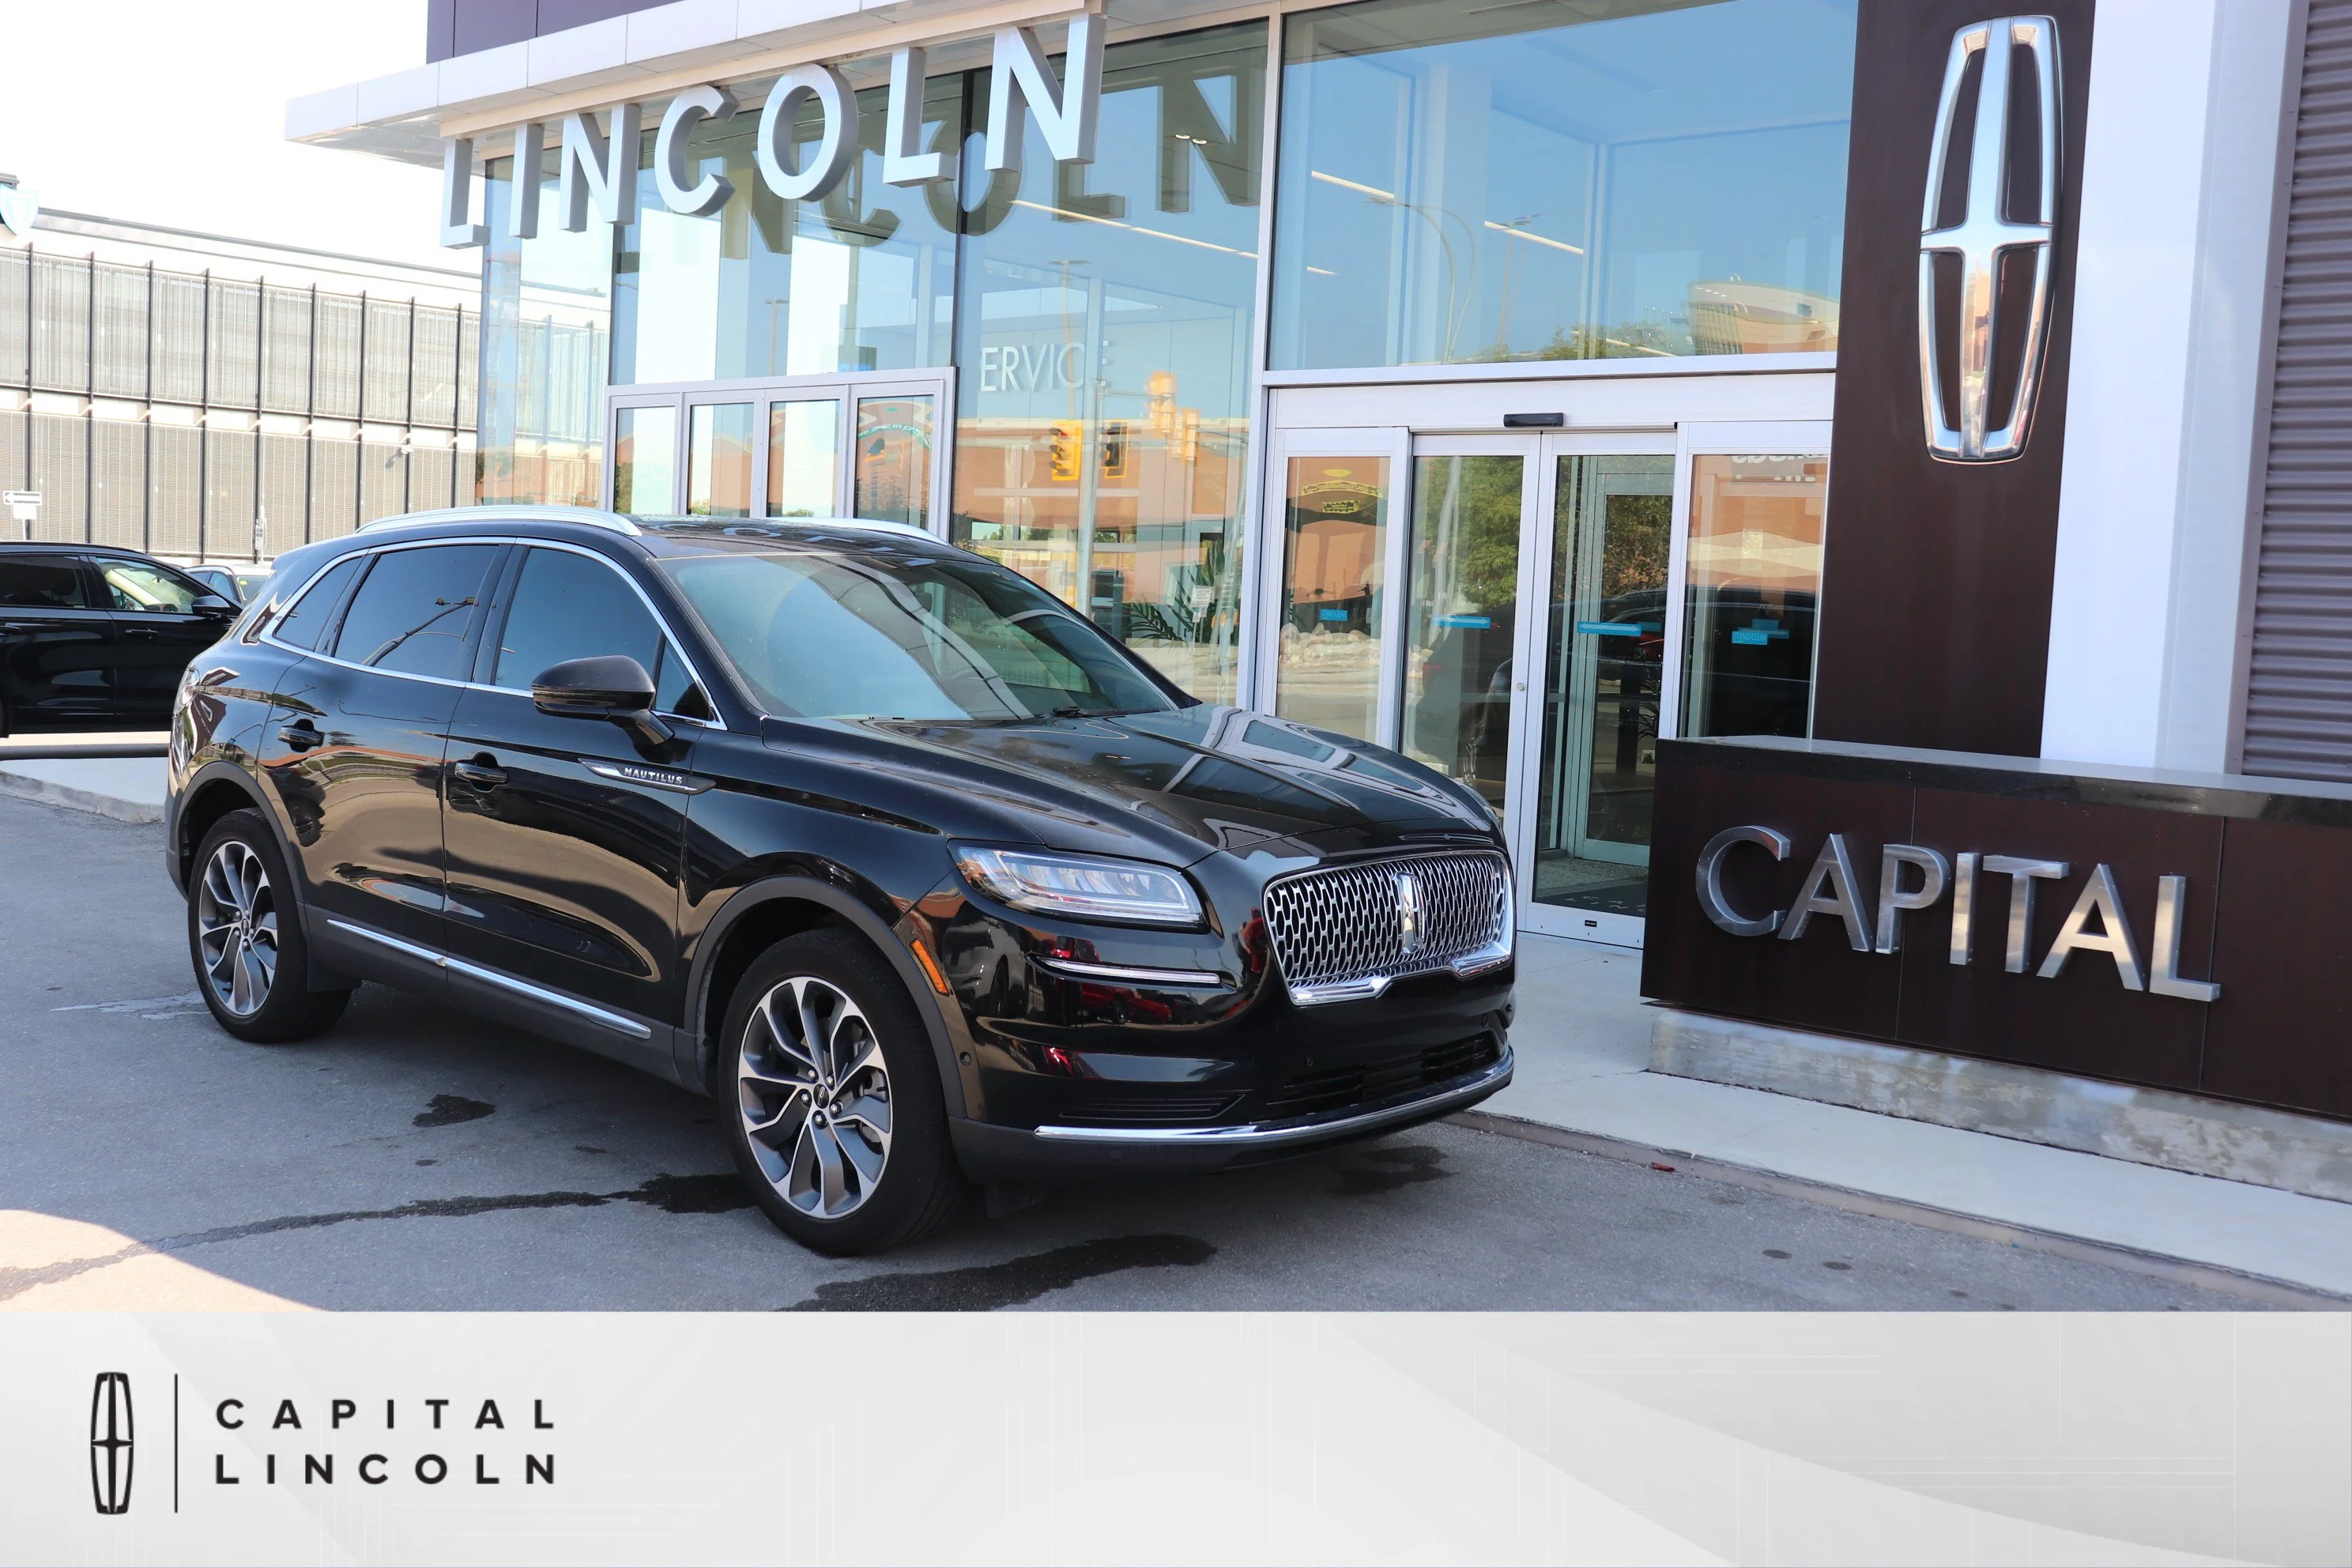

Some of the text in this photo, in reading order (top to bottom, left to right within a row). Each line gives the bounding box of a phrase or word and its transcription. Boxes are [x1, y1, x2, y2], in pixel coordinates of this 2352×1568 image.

[439, 12, 1106, 249] LINCOLN
[980, 341, 1109, 392] ERVIC
[1732, 631, 1767, 641] STAND CLEAR
[624, 767, 684, 785] NAUTILUS
[1695, 824, 2221, 1002] CAPITAL
